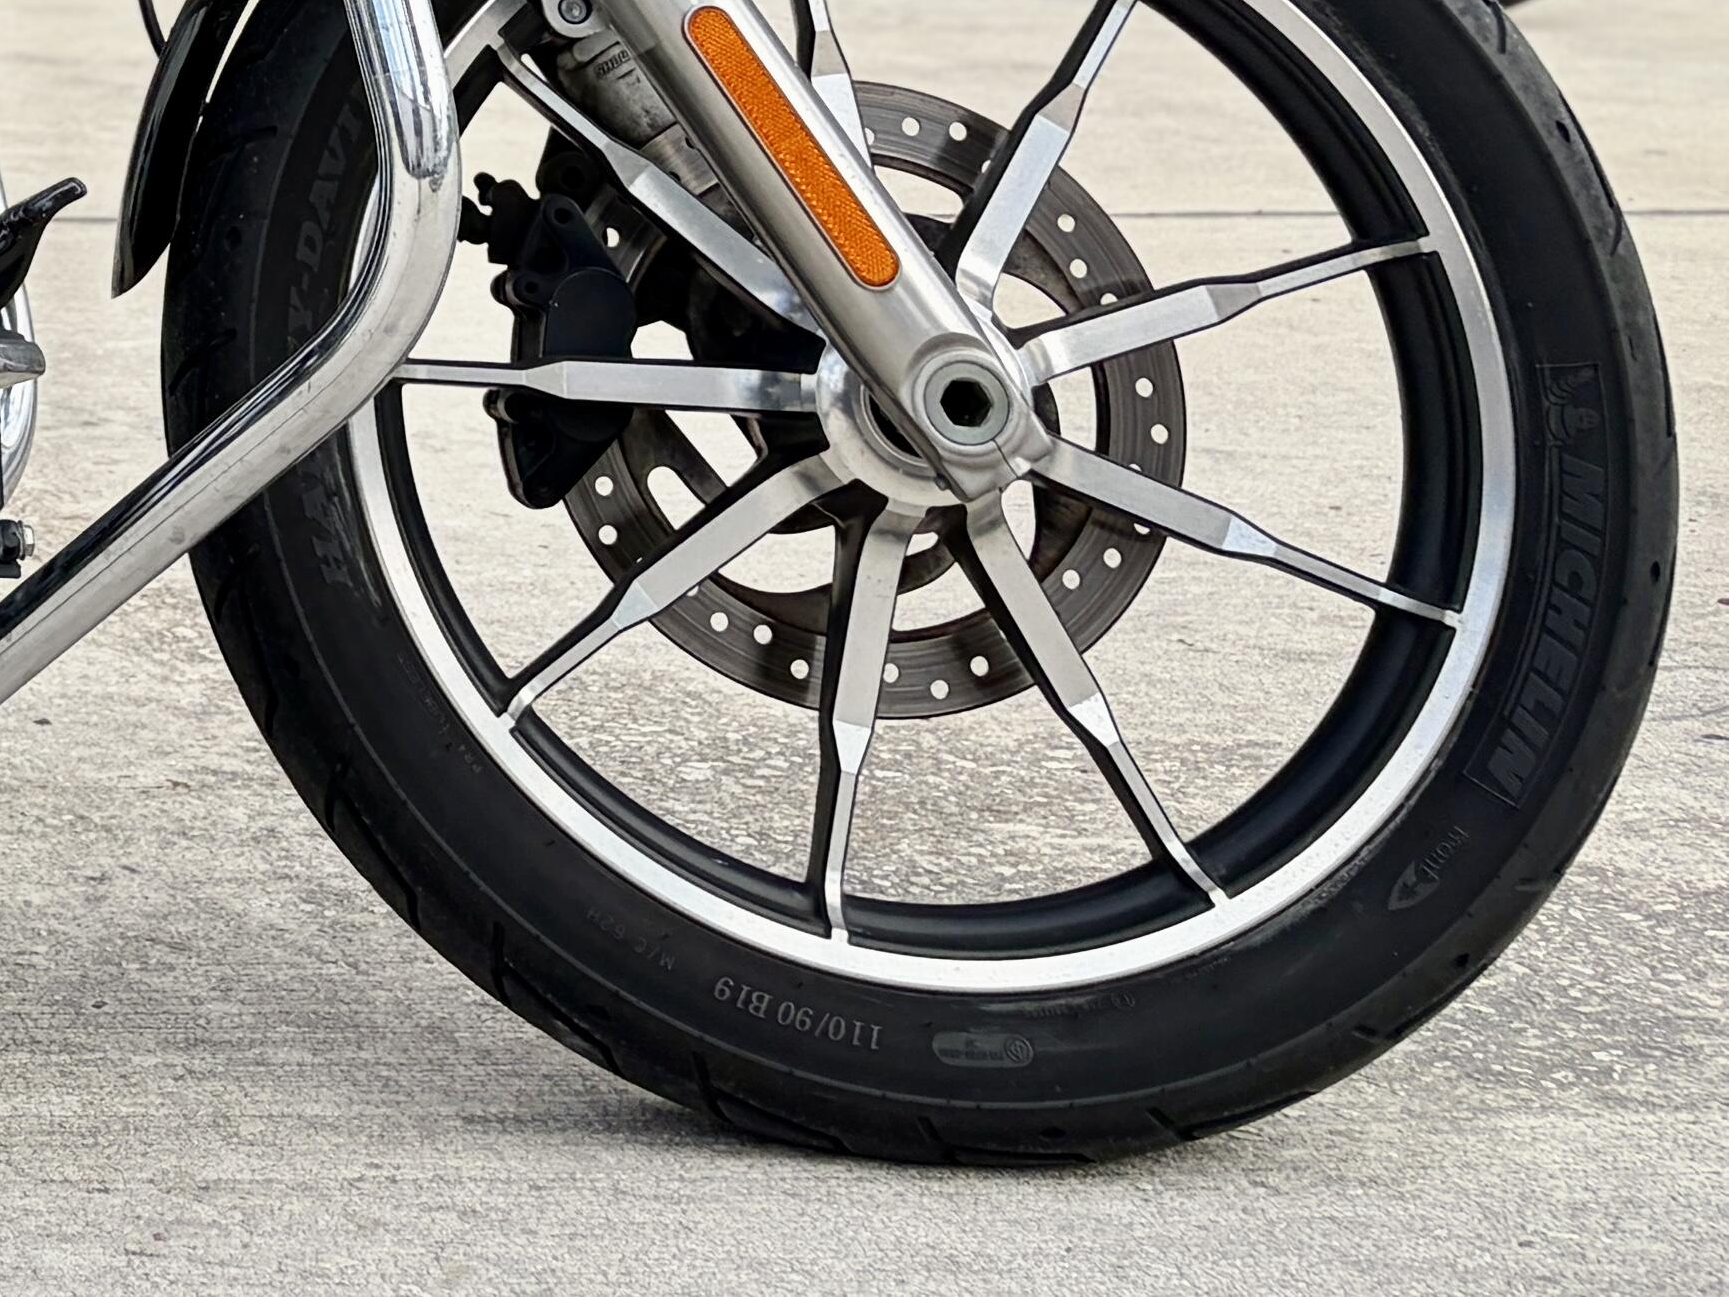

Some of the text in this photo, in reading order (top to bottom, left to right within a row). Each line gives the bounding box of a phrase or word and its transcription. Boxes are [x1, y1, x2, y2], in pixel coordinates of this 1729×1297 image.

[1487, 452, 1606, 801] MICHELIN
[712, 975, 775, 1020] B19
[775, 1000, 883, 1052] 110/90
